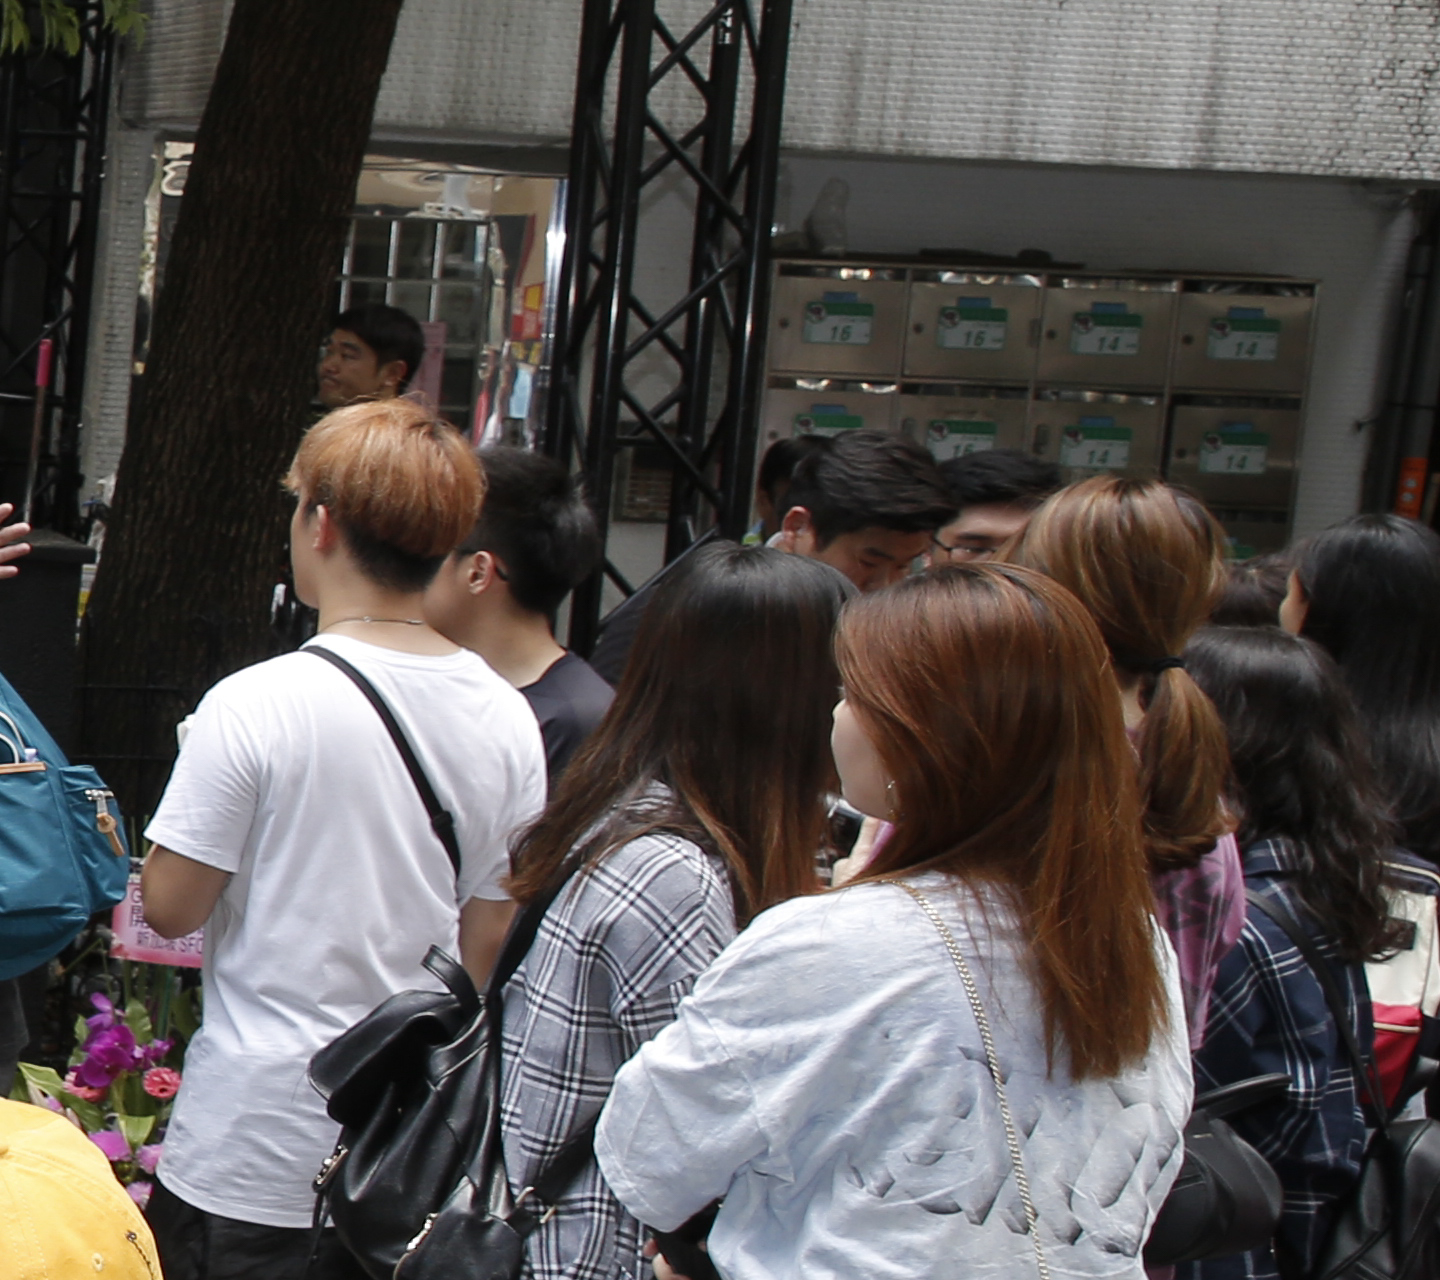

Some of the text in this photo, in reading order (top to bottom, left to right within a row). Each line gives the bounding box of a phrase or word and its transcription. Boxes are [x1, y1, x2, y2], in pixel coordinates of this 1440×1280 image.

[830, 325, 853, 341] 16
[964, 330, 986, 346] 16
[1097, 336, 1121, 352] 14
[1235, 341, 1259, 357] 14
